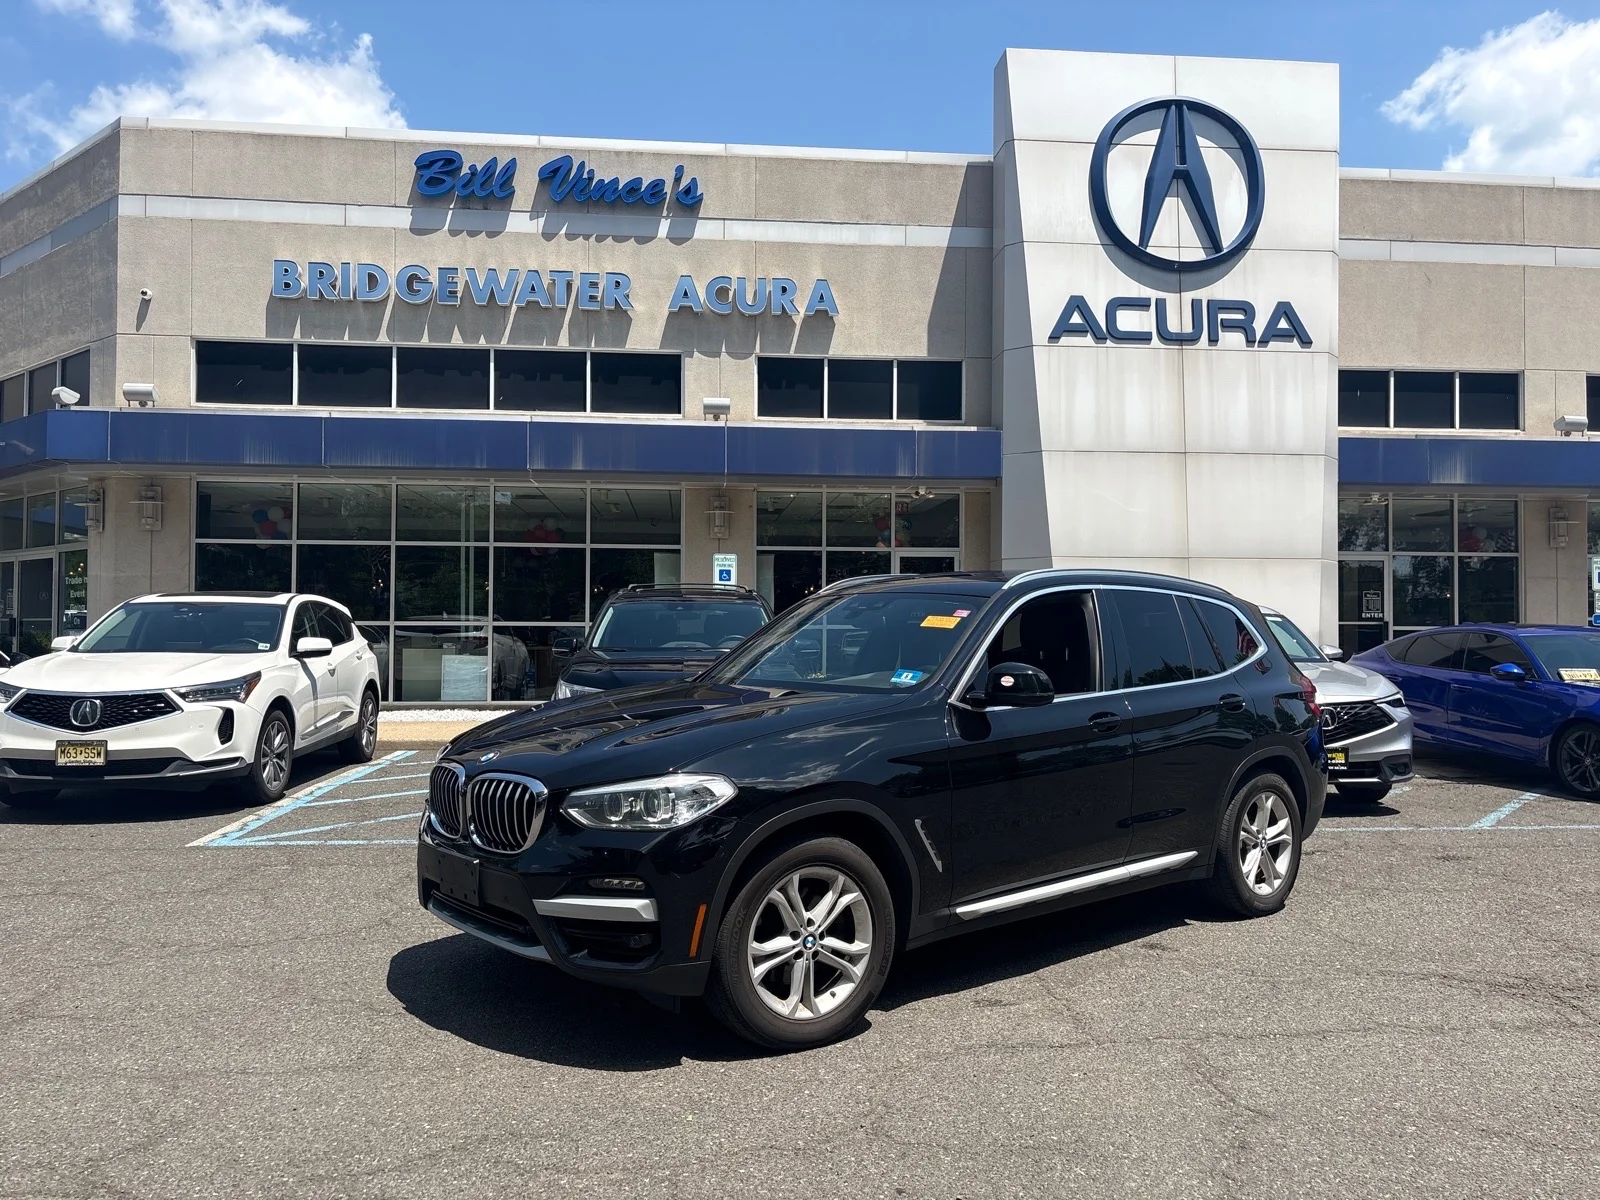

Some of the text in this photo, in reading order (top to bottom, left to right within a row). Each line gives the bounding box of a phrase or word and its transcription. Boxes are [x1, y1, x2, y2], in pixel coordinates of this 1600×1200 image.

[414, 150, 704, 207] Bill Vince's
[272, 259, 840, 317] BRIDGEWATER ACURA
[1048, 294, 1313, 348] ACURA
[70, 590, 85, 598] Event
